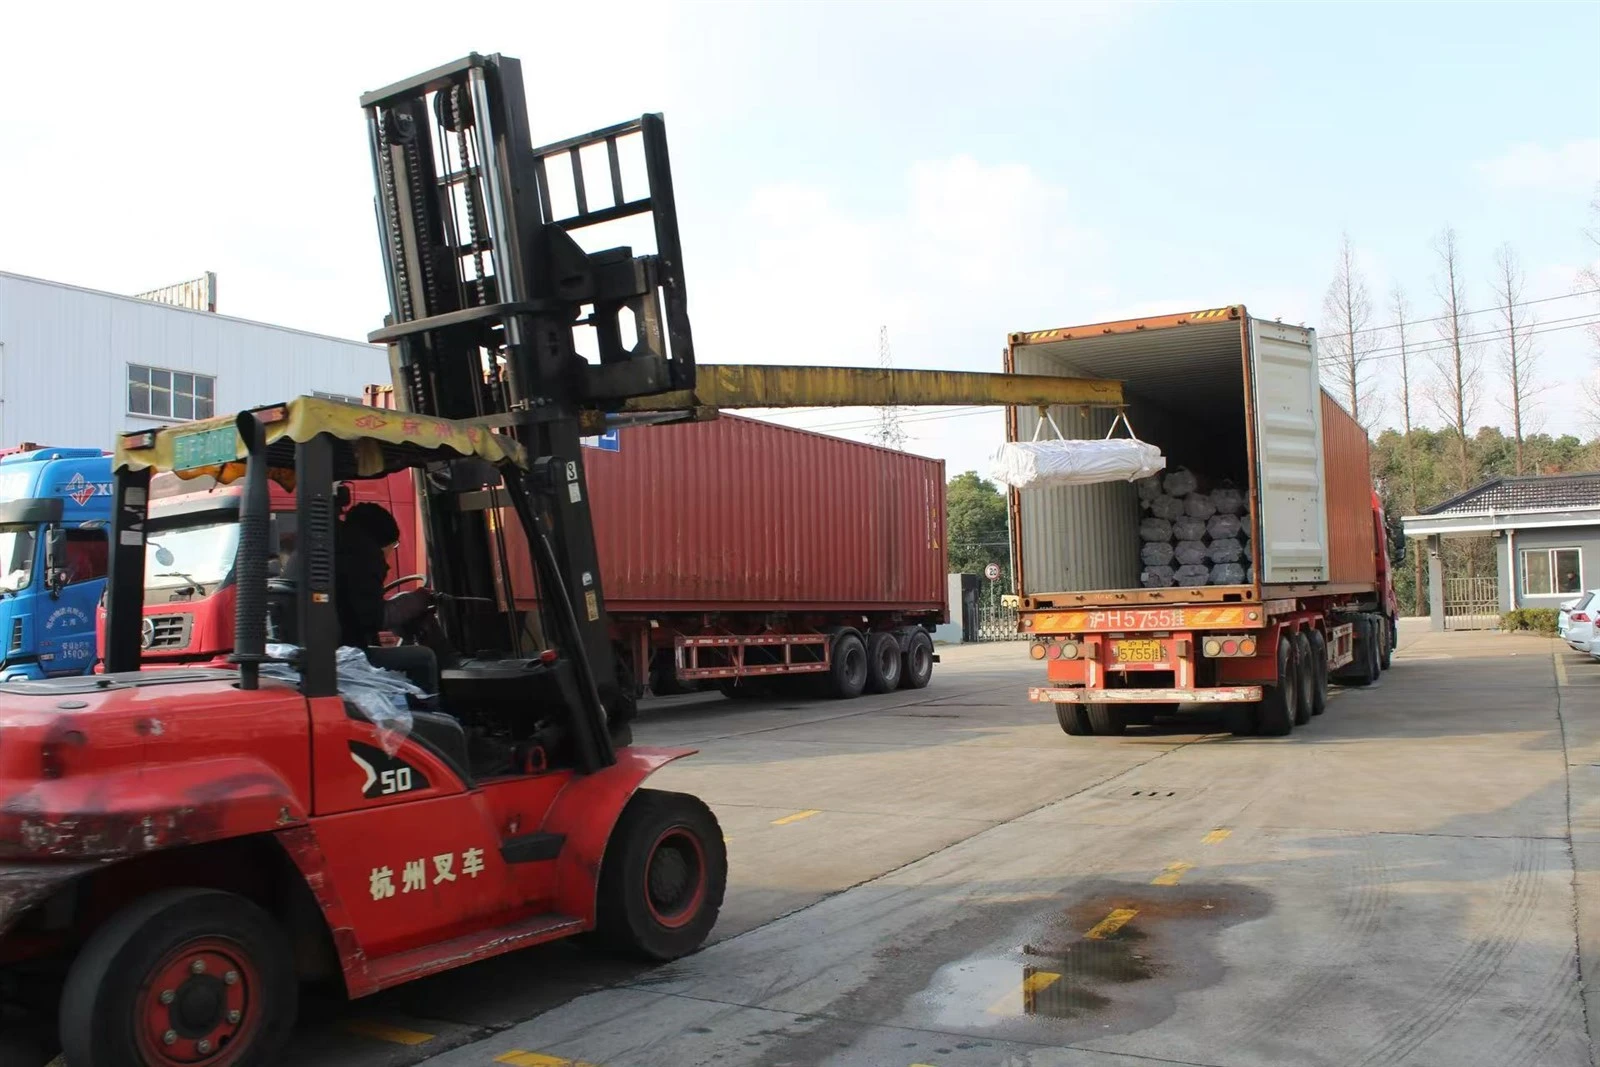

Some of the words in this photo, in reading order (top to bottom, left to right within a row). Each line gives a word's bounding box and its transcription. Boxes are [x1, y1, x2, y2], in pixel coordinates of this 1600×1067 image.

[380, 767, 412, 795] 50
[369, 848, 485, 901] 杭州叉车
